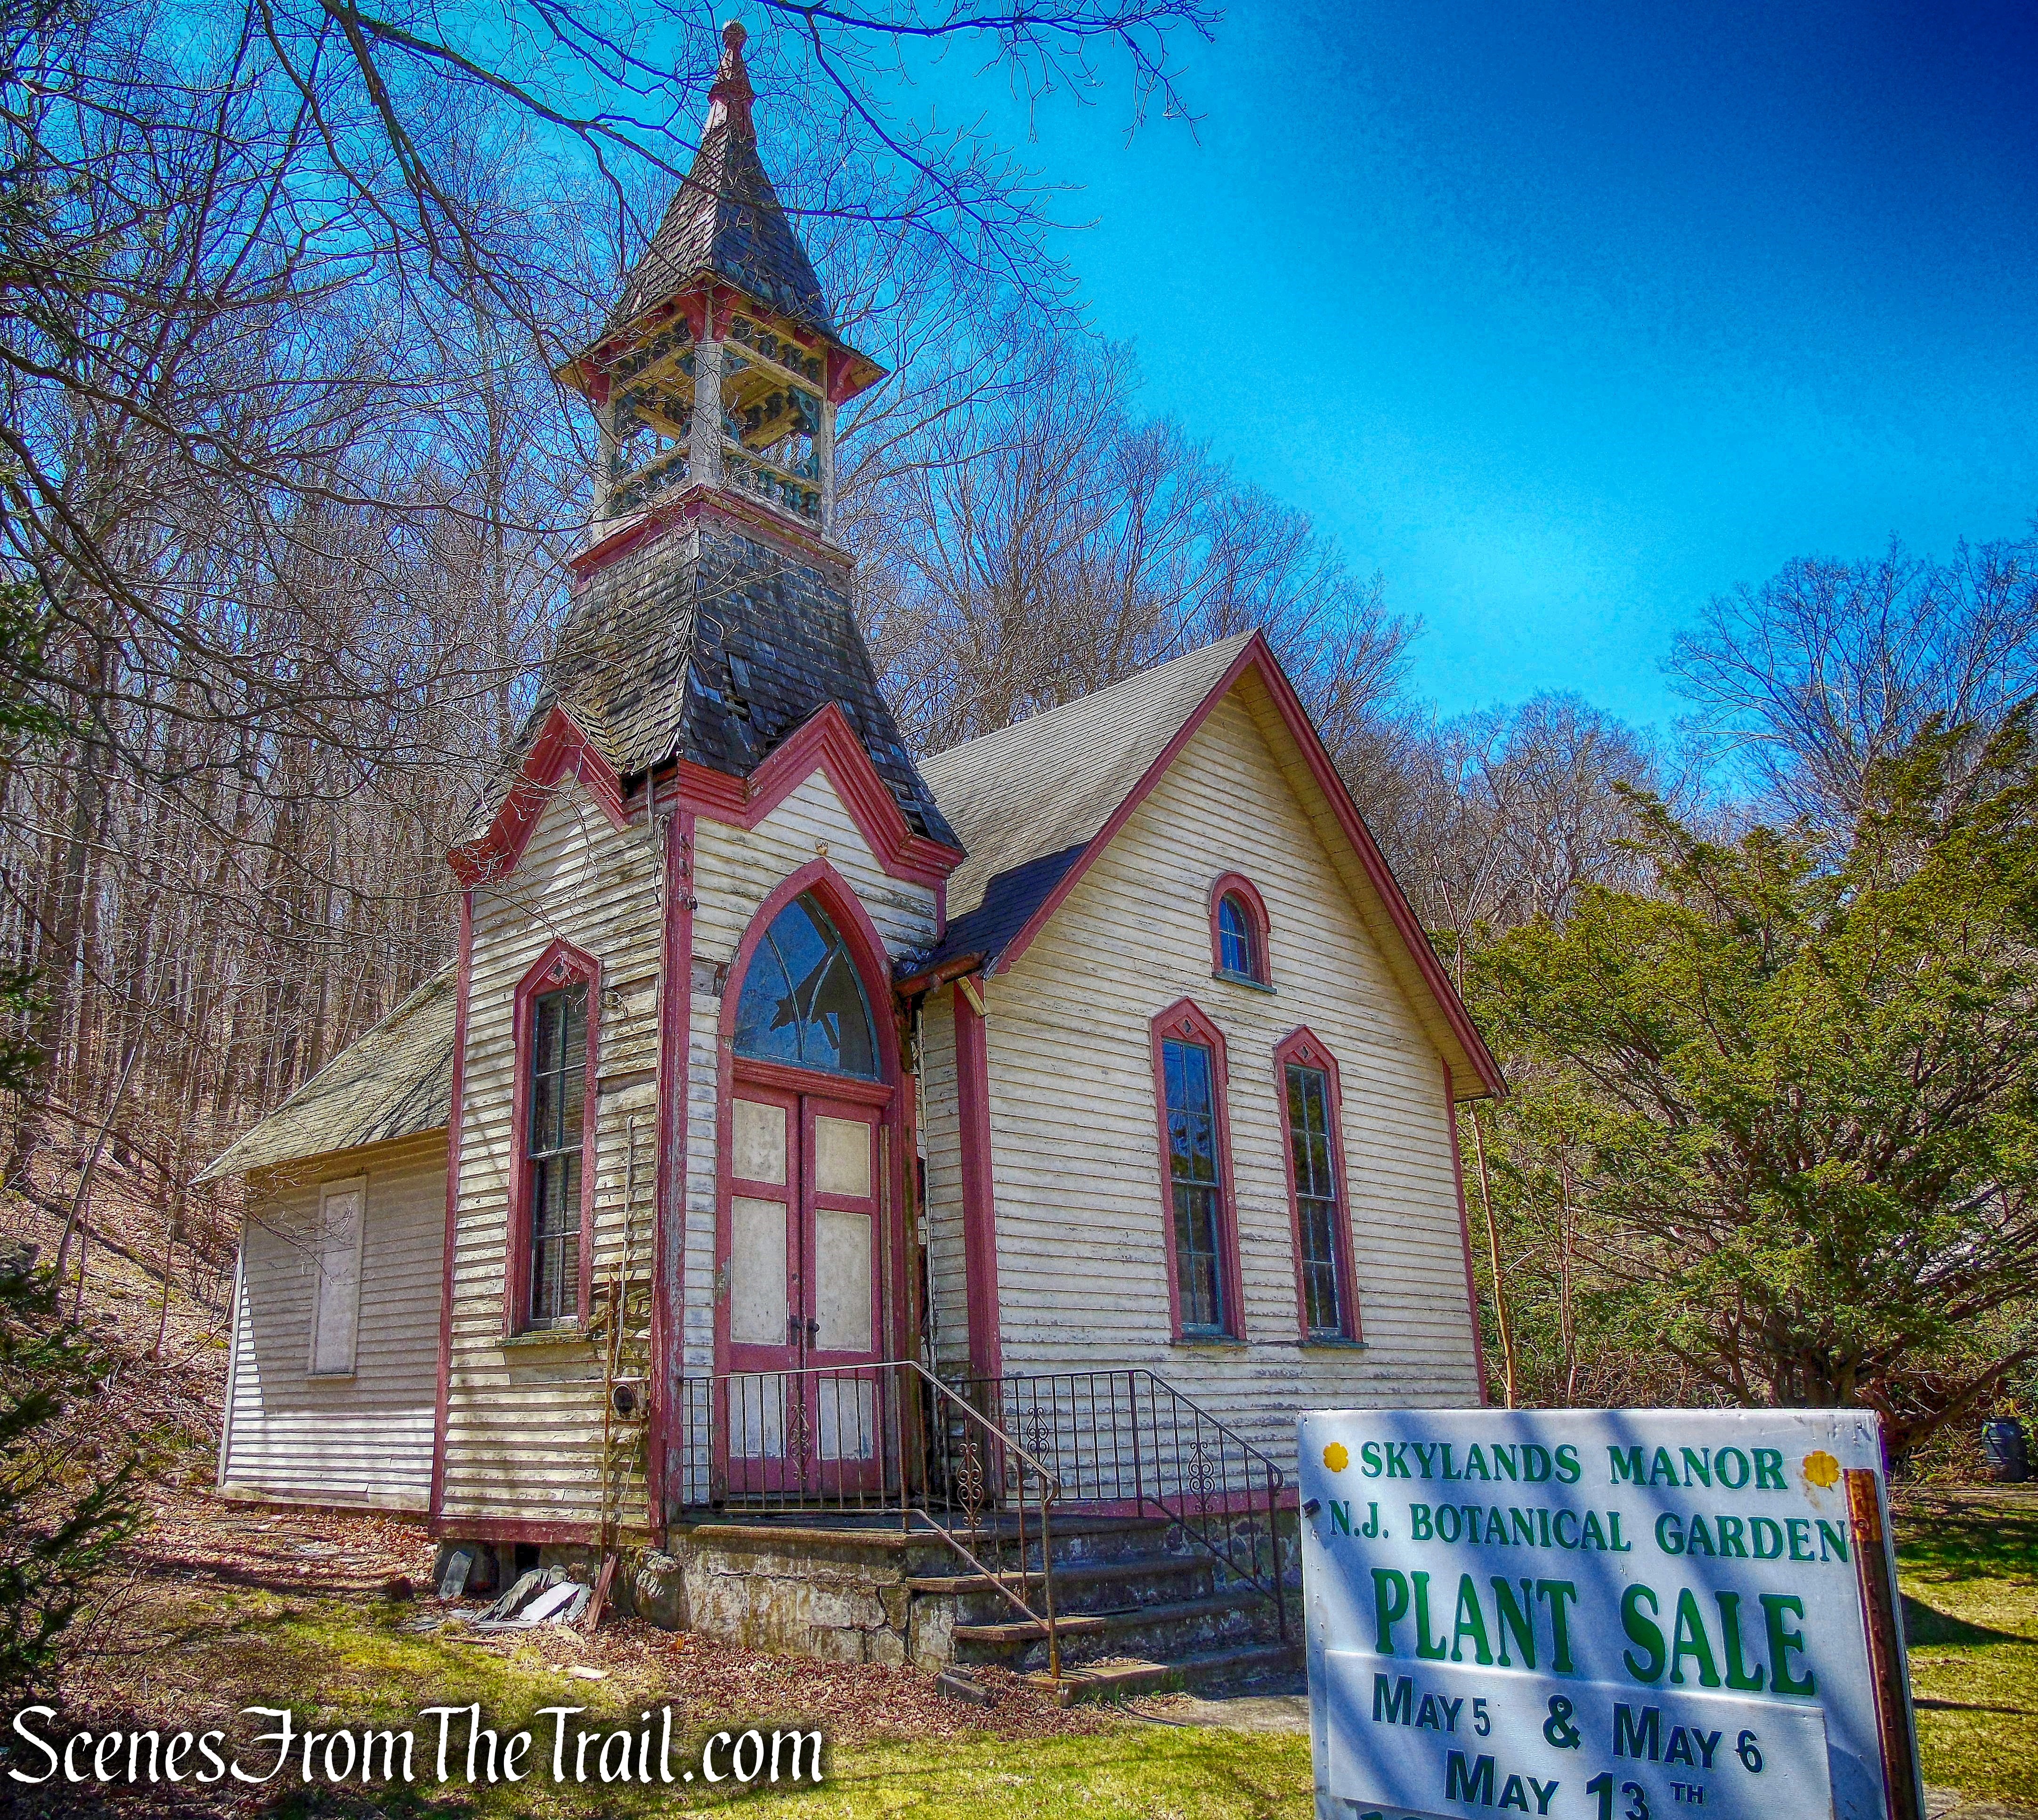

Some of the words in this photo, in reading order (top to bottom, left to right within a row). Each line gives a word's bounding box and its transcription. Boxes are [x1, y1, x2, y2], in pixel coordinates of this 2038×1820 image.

[1360, 1440, 1581, 1484] SKYLANDS
[1607, 1445, 1788, 1490] MANOR
[1328, 1499, 1388, 1539] N.J.
[1409, 1503, 1631, 1552] BOTANICAL
[1654, 1511, 1849, 1563] GARDEN
[1370, 1568, 1577, 1674] PLANT
[1620, 1583, 1816, 1696] SALE
[1372, 1673, 1463, 1733] MAY
[1472, 1698, 1491, 1737] 5
[1542, 1694, 1581, 1749] &
[1612, 1702, 1721, 1769] MAY
[1735, 1730, 1764, 1774] 6
[1444, 1749, 1559, 1815] MAY
